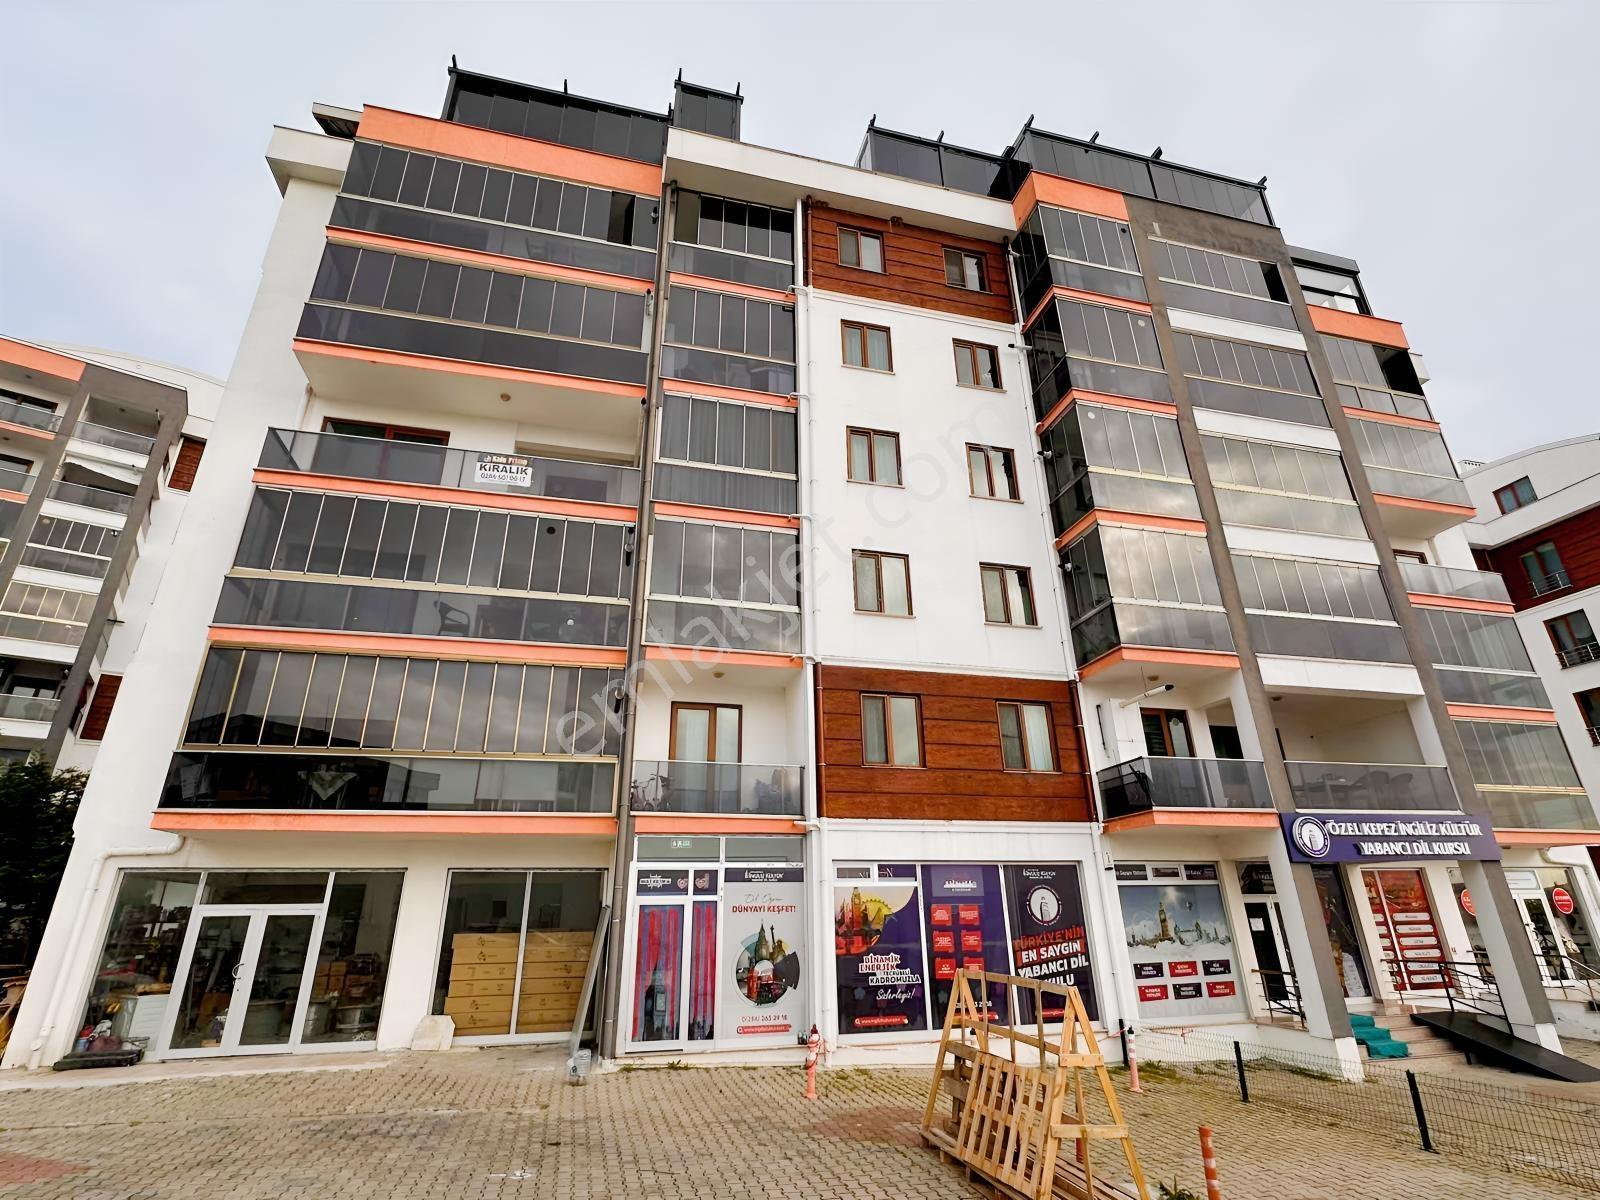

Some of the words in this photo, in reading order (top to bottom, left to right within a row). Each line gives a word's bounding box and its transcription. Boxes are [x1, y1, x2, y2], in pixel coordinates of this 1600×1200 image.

[1325, 820, 1362, 836] ÖZEL
[1362, 822, 1398, 836] KEPEZ
[1438, 820, 1483, 836] KÜLTÜR
[1360, 841, 1412, 855] YABANCI
[1412, 839, 1432, 855] DİL
[1432, 841, 1472, 855] KURSU
[1013, 925, 1085, 951] TÜRKİYE'NİN
[864, 953, 900, 964] DİNAMİK
[1022, 949, 1038, 964] EN
[1018, 959, 1068, 978] YABANCI
[1070, 954, 1089, 969] DİL
[869, 975, 920, 985] KADROMUZLA
